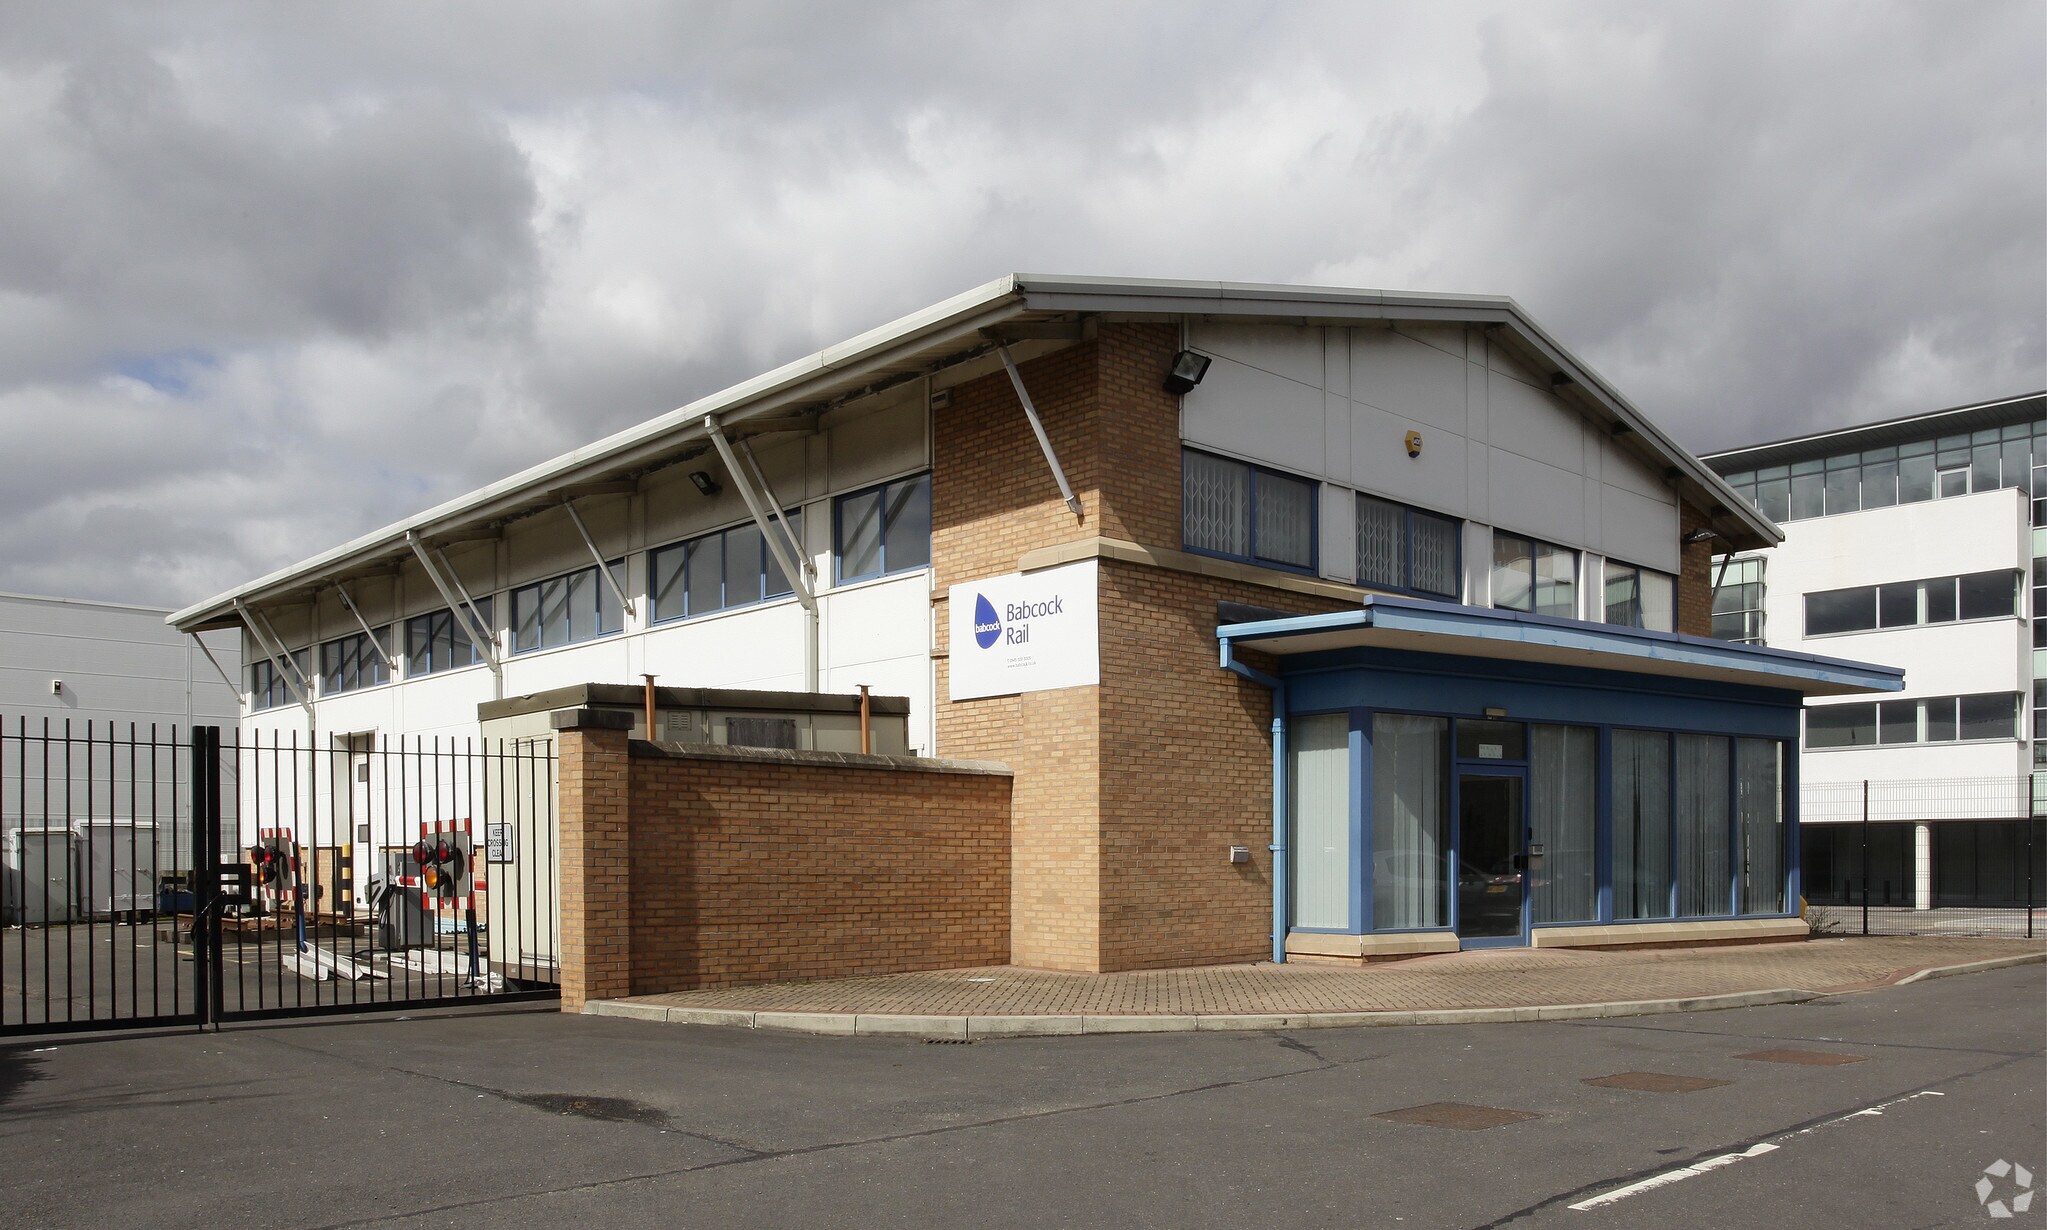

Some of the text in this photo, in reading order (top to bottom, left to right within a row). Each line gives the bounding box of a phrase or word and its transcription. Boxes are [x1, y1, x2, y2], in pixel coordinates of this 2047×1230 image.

[1006, 595, 1063, 621] Babcock
[975, 621, 1000, 633] babcock
[1006, 624, 1029, 645] Rail
[487, 839, 508, 847] CROSSG
[492, 849, 504, 857] CLEA
